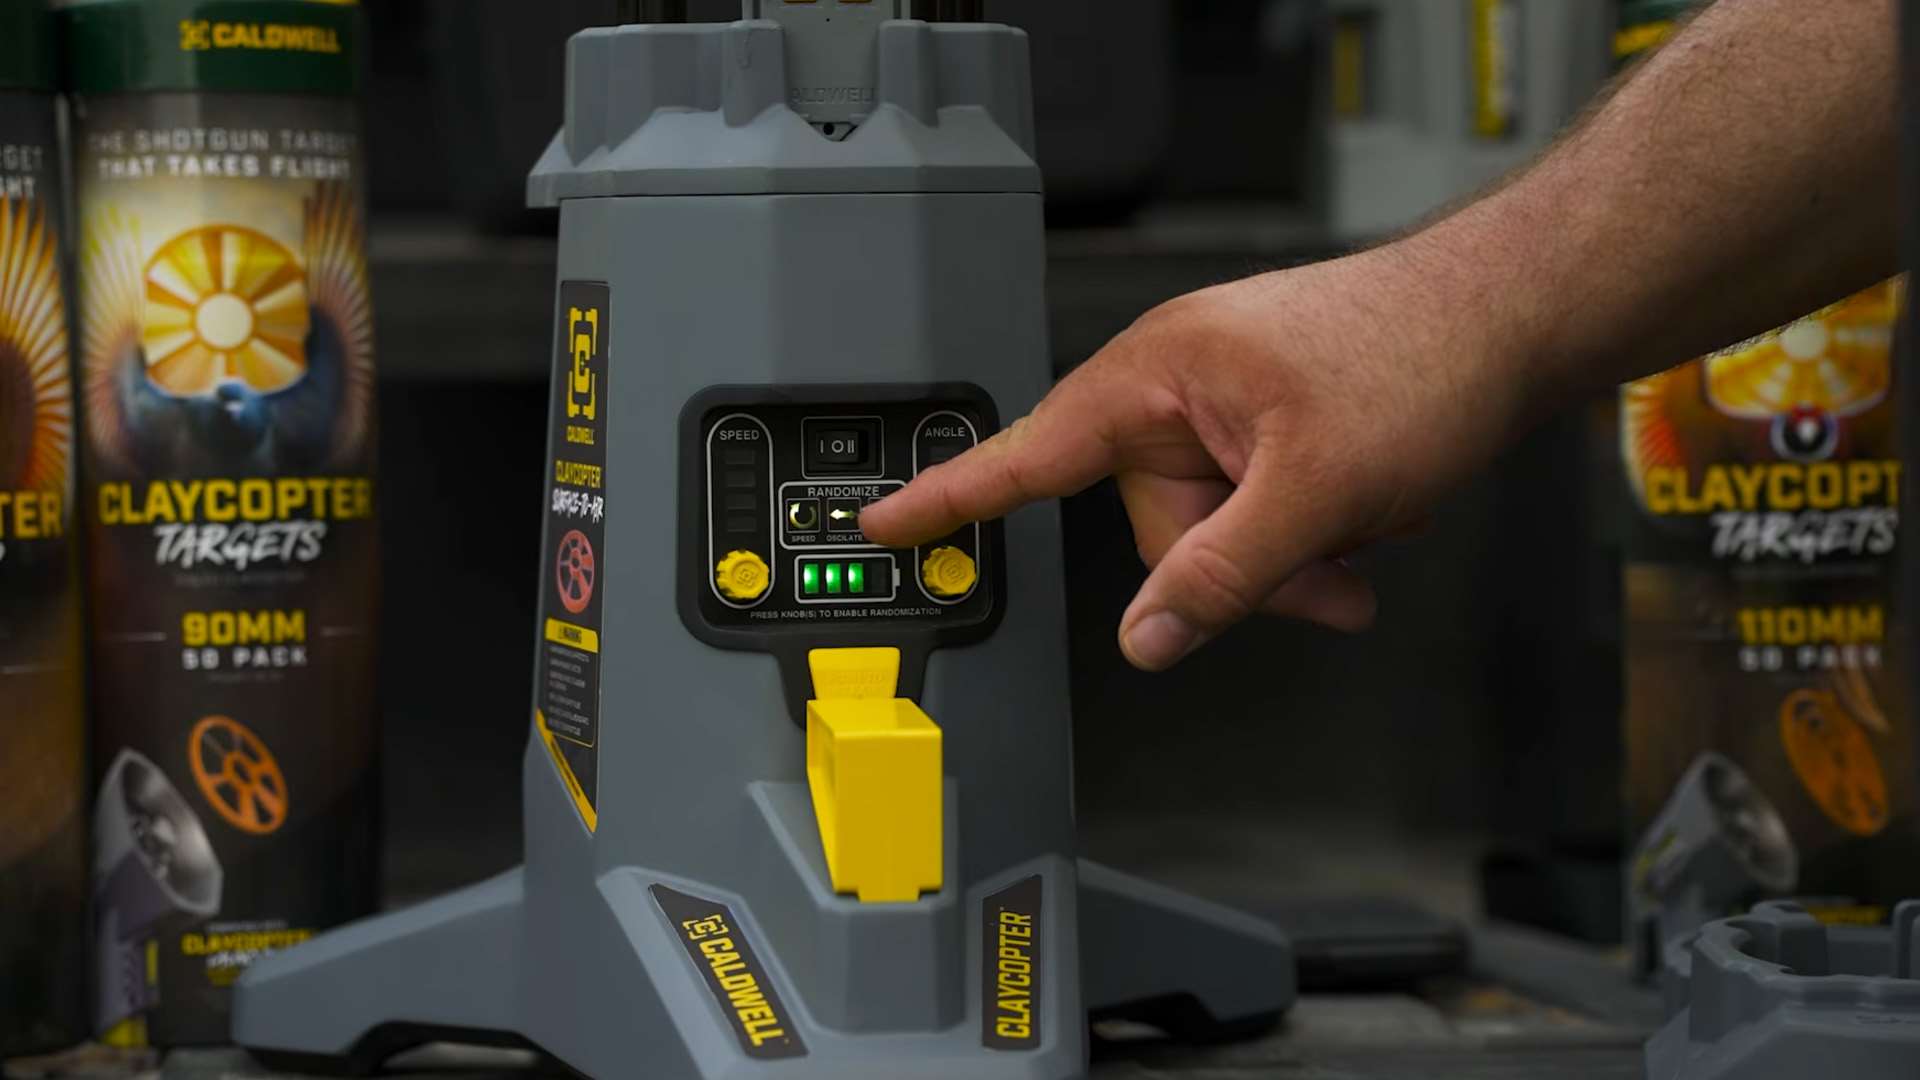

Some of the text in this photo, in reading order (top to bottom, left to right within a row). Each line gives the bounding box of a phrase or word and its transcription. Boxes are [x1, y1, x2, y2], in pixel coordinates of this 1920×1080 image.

[212, 21, 341, 54] CALDWELL
[134, 128, 269, 151] SHOTGUN
[98, 155, 155, 177] THAT
[167, 153, 260, 177] TAKES
[719, 430, 760, 441] SPEED
[924, 426, 966, 438] ANGLE
[555, 460, 602, 489] CLAYCOPTER
[1646, 459, 1903, 517] CLAYCOPT
[98, 477, 373, 525] CLAYCOPTER
[807, 486, 880, 498] RANDOMIZE
[153, 519, 327, 571] TARGETS
[1710, 505, 1899, 564] TARGETS
[181, 609, 307, 646] 90MM
[750, 611, 778, 619] PRESS
[820, 609, 831, 618] TO
[833, 609, 867, 617] ENABLE
[870, 607, 942, 617] RANDOMIZATION
[233, 645, 308, 668] PACK
[996, 910, 1032, 1038] CLAYCOPTER
[699, 936, 785, 1046] CALDWELL
